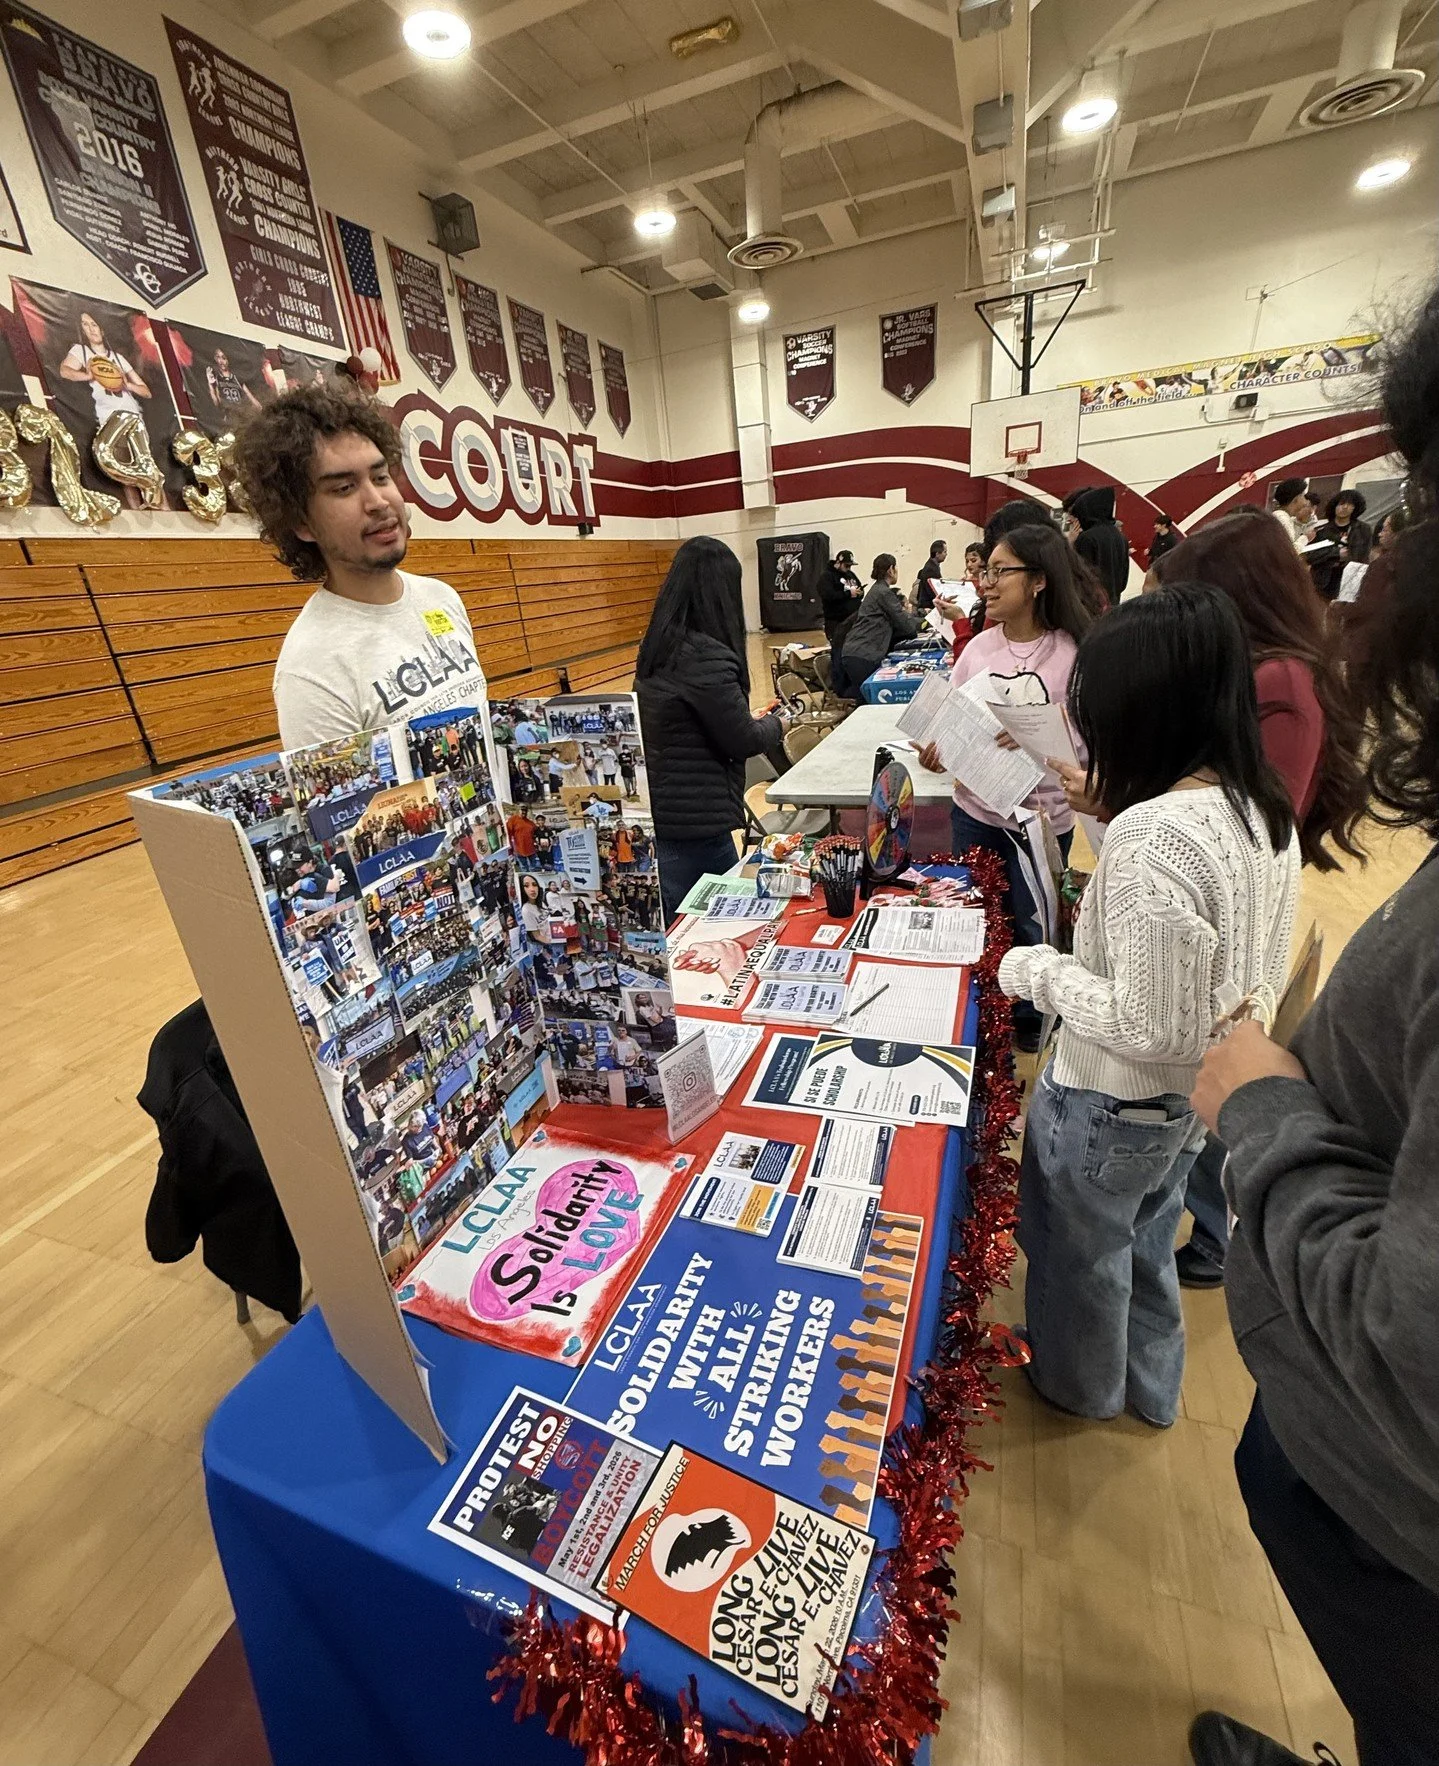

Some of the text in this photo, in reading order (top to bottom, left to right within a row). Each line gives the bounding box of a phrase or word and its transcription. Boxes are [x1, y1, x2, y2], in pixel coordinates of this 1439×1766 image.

[73, 122, 144, 179] 2016
[228, 115, 301, 171] CHAMPIONS
[243, 176, 312, 220] CROSS COUNTRY
[253, 213, 322, 260] CHAMPIONS
[400, 252, 440, 278] VARSITY
[786, 343, 834, 363] CHAMPIONS
[796, 329, 832, 345] VARSITY
[882, 322, 935, 344] CHAMPIONS
[1247, 350, 1282, 363] HIGH
[1288, 343, 1332, 355] SCHOO
[1093, 398, 1117, 412] and
[1136, 395, 1155, 404] the
[1229, 372, 1301, 390] CHARACTER
[400, 408, 594, 518] COURT
[372, 640, 480, 716] LCLAA
[423, 690, 457, 717] ANGELES
[458, 678, 487, 699] CHAPTE
[378, 850, 416, 875] LCLAA
[808, 1087, 820, 1096] SE
[812, 1067, 829, 1087] PUEDE
[822, 1064, 848, 1107] SCHOLARSHIP
[713, 1140, 735, 1168] LCLAA
[441, 1164, 537, 1255] LCLAA
[490, 1159, 623, 1306] Solidarity
[496, 1188, 537, 1232] Angeles
[561, 1188, 645, 1273] LOVE
[593, 1283, 662, 1372] LCLAA
[606, 1252, 713, 1438] SOLIDARITY
[667, 1304, 726, 1392] WITH
[707, 1323, 757, 1393] ALL
[723, 1289, 803, 1458] STRIKING
[759, 1295, 836, 1468] WORKERS
[453, 1401, 541, 1532] PROTEST
[517, 1414, 560, 1471] NO
[532, 1416, 573, 1480] SHOPPING
[501, 1524, 516, 1542] ICE
[558, 1449, 623, 1568] May 1st, 2nd and 3rd, 2026
[567, 1454, 633, 1573] RESISTANCE & UNITY
[576, 1459, 643, 1579] LEGALIZATION
[615, 1455, 691, 1592] MARCH FOR JUSTICE
[711, 1510, 801, 1664] LONG LIVE
[735, 1596, 764, 1676] CESAR
[774, 1513, 820, 1587] CHAVEZ
[755, 1527, 842, 1688] LONG LIVE
[781, 1619, 807, 1698] CESAR
[818, 1529, 862, 1606] CHAVEZ
[846, 1597, 855, 1608] CA
